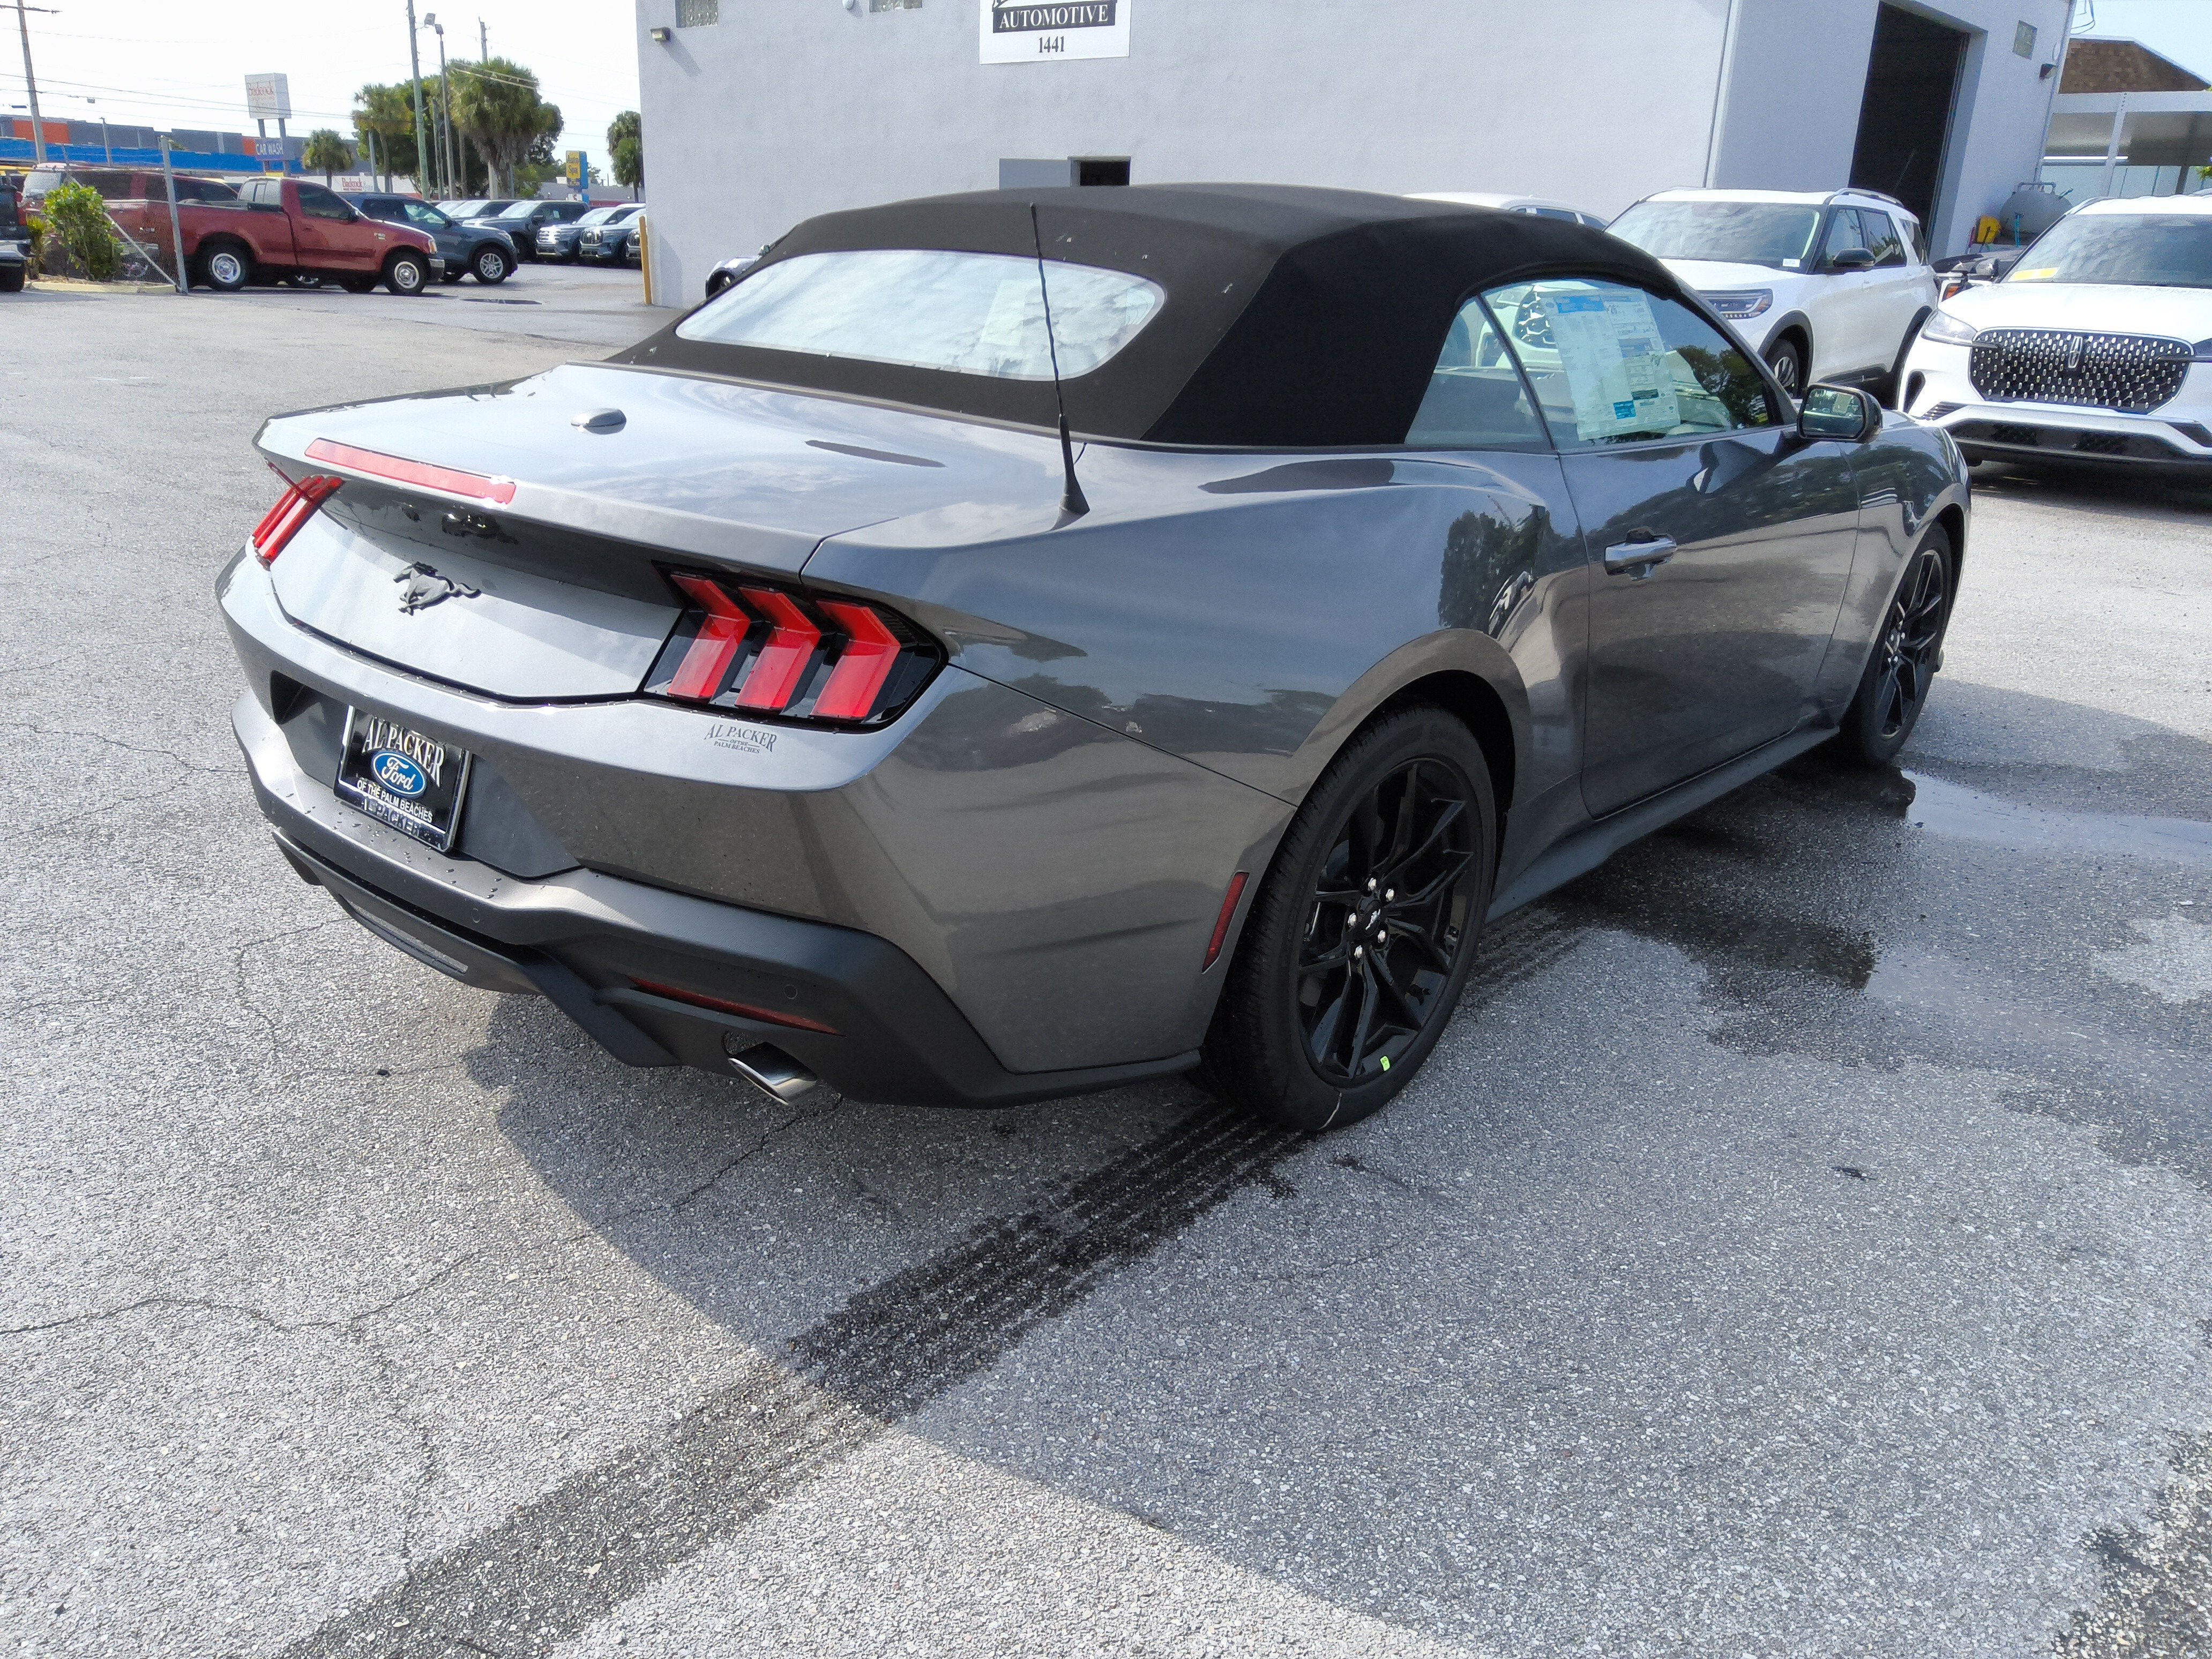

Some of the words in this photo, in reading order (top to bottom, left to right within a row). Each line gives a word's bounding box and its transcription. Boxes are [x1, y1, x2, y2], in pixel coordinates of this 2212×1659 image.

[1000, 5, 1108, 28] AUTOMOTIVE
[1038, 36, 1065, 53] 1441
[256, 144, 267, 155] CAR
[268, 143, 284, 155] WASH
[704, 723, 723, 740] AL
[726, 726, 777, 752] PACKER
[714, 741, 730, 749] PALM
[731, 744, 760, 754] BEACHES
[362, 718, 386, 753] AL
[386, 725, 444, 787] PACKER
[381, 757, 416, 790] Ford
[357, 780, 367, 790] OF
[368, 784, 381, 797] THE
[381, 790, 400, 808] PALM
[401, 799, 432, 824] BEACHES
